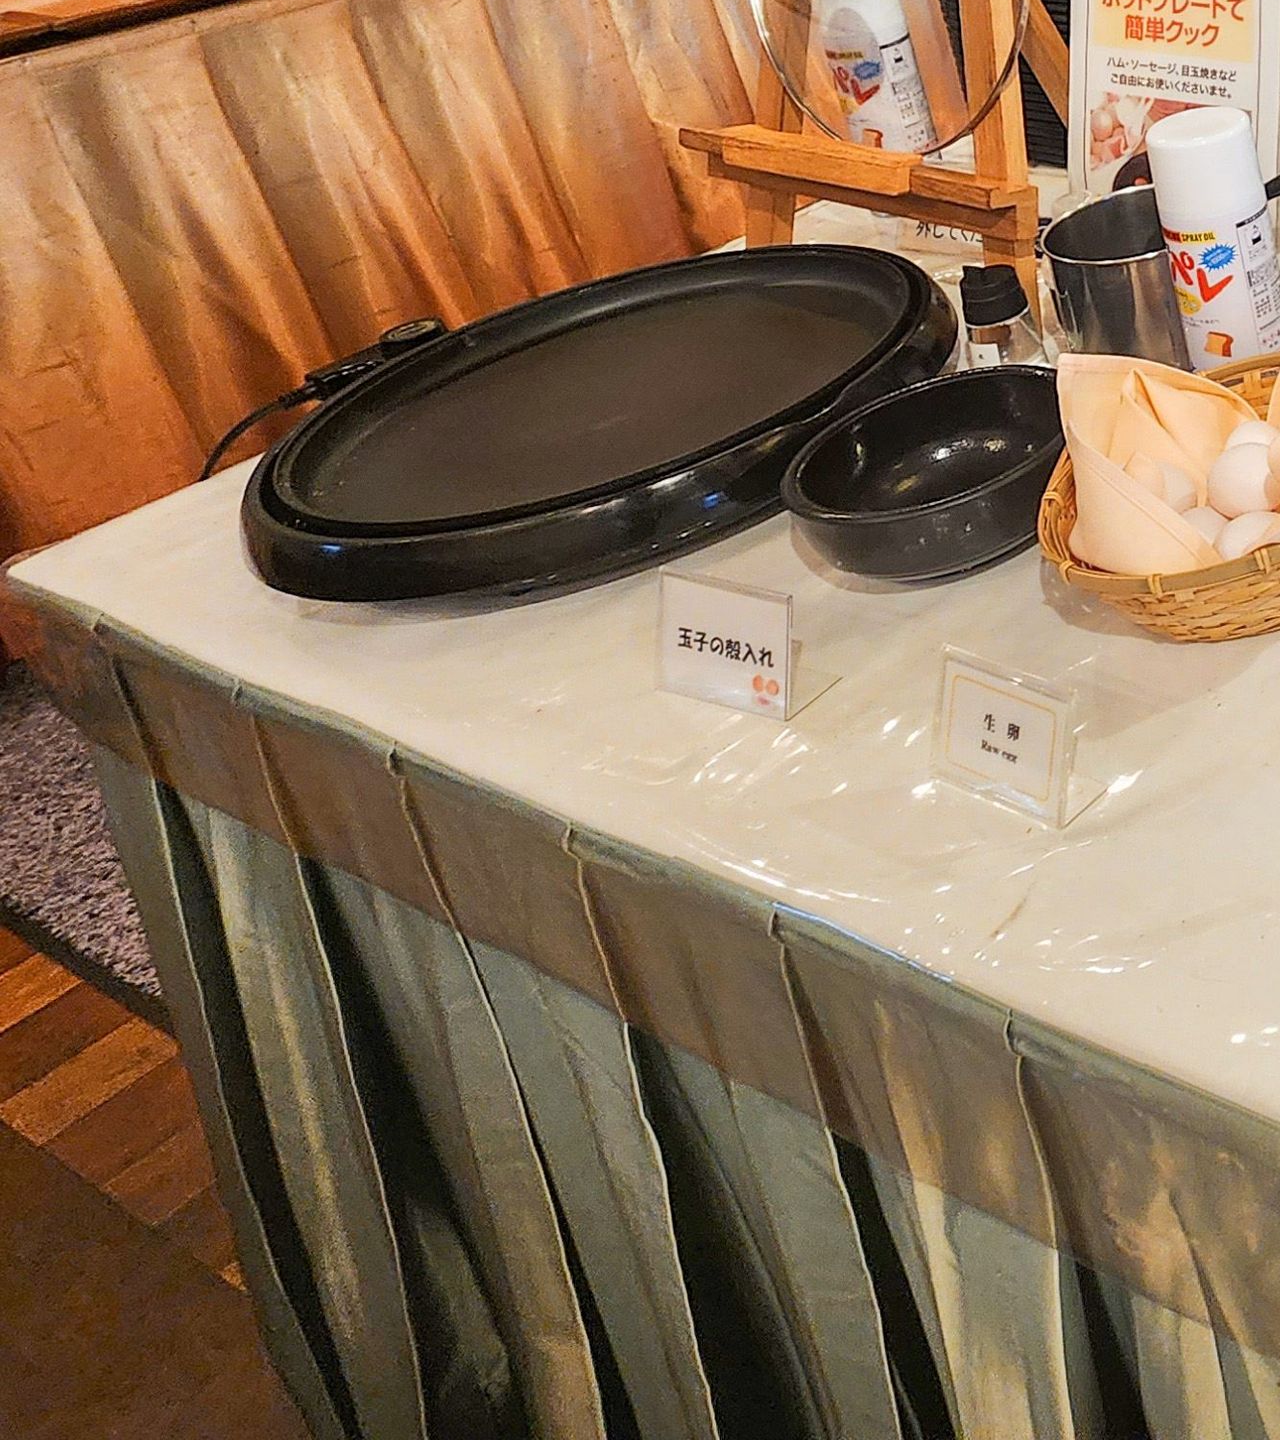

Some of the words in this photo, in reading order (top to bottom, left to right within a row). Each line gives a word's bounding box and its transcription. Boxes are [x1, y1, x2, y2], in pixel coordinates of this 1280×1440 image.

[1125, 14, 1220, 47] 簡単クック
[1107, 57, 1237, 82] ハム・ソーセージ、目玉焼きなど
[1110, 74, 1232, 99] ご自由にお使いくださいませ。
[1181, 233, 1202, 242] SPRAY
[677, 627, 774, 667] 玉子の殻入れ
